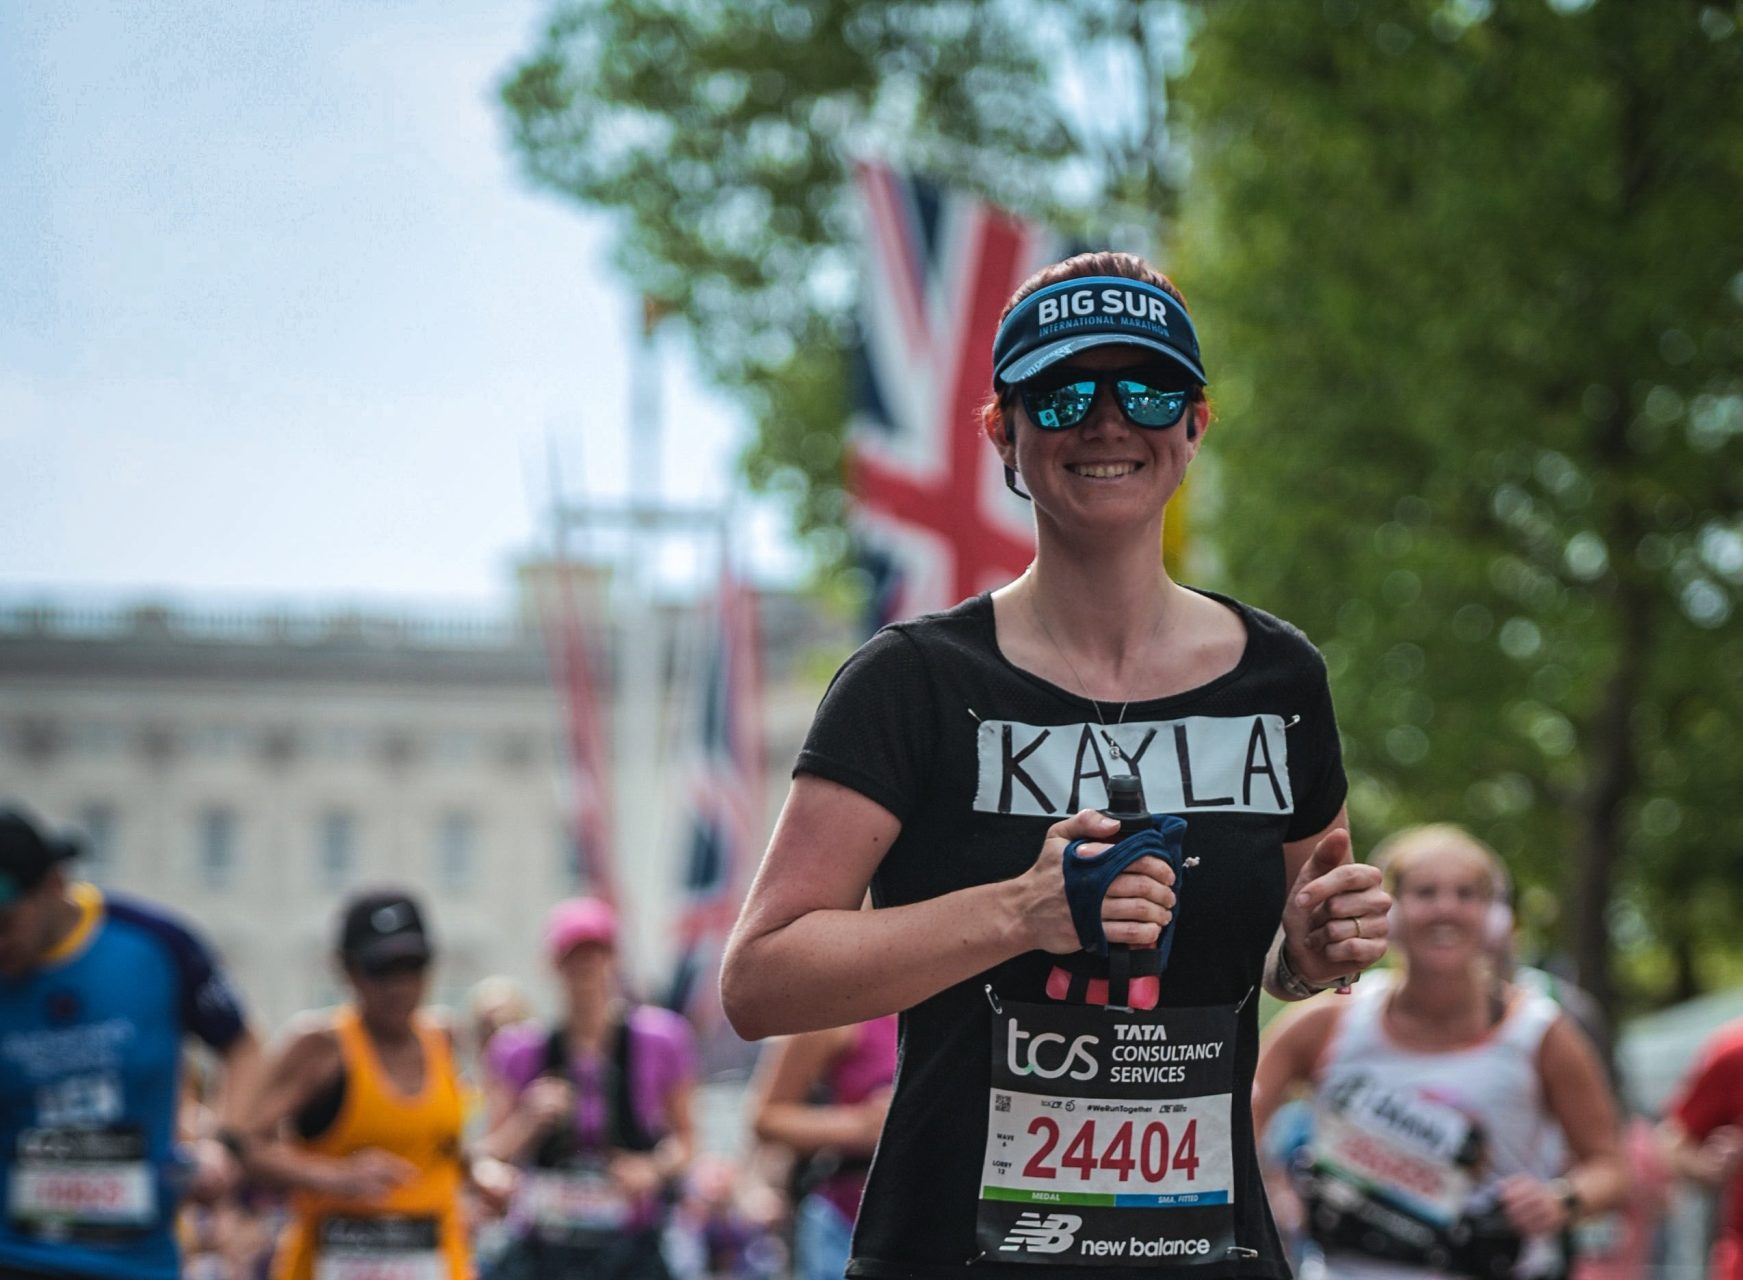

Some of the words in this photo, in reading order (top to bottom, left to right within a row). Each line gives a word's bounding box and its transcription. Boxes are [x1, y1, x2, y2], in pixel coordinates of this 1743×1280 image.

[1039, 290, 1095, 326] BIG
[1101, 289, 1168, 327] SUR
[1039, 315, 1115, 337] INTERNATIONAL
[1120, 316, 1170, 337] MARATHON
[998, 715, 1288, 815] KAYLA
[1113, 1024, 1167, 1041] TATA
[1007, 1017, 1099, 1081] tcs
[1111, 1041, 1223, 1062] CONSULTANCY
[1110, 1065, 1186, 1083] SERVICES
[1086, 1104, 1153, 1114] #WeRunTogether
[996, 1133, 1014, 1141] WAVE
[1022, 1116, 1200, 1183] 24404
[1031, 1192, 1061, 1202] MEDAL
[1080, 1239, 1126, 1256] new
[1129, 1237, 1210, 1257] balance
